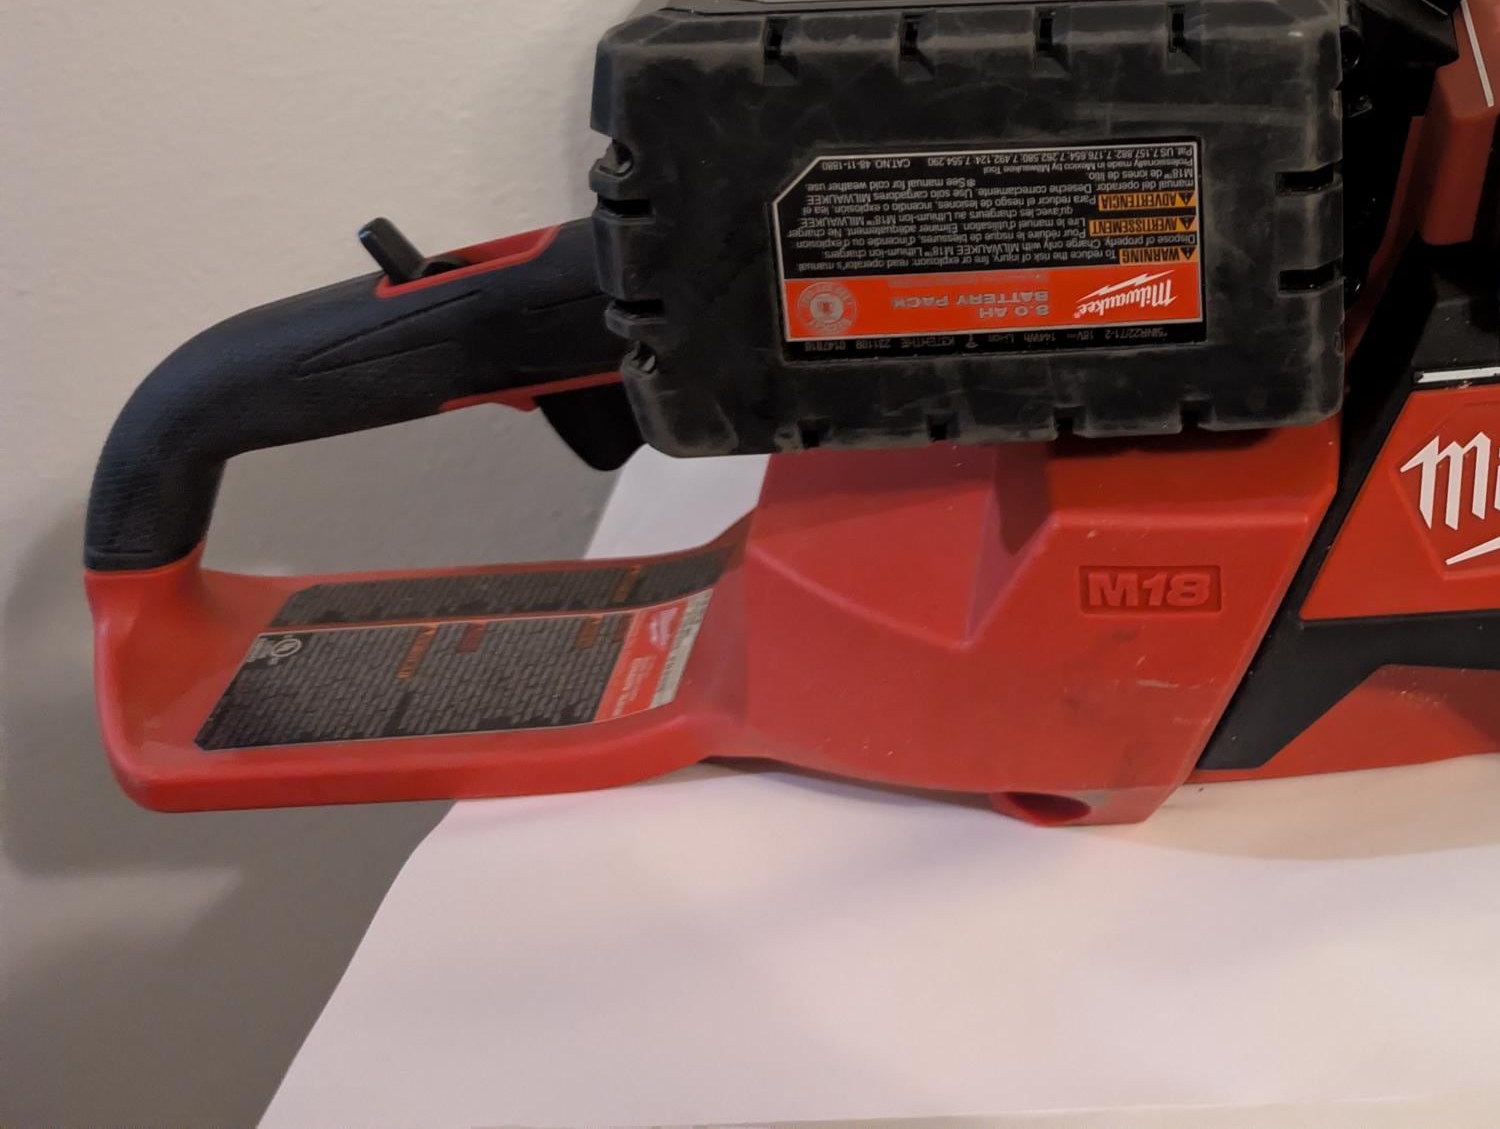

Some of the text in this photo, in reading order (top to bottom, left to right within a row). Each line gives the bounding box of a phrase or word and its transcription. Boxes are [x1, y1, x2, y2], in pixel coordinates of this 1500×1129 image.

[1063, 162, 1095, 171] Mexico
[1106, 160, 1131, 169] made
[1133, 155, 1192, 168] Professionally
[983, 166, 1001, 174] Tool
[1003, 164, 1049, 173] Milwaukee
[1122, 169, 1147, 179] iones
[1086, 171, 1104, 181] litio.
[828, 181, 866, 192] weather
[869, 180, 889, 190] cold
[892, 179, 905, 189] for
[907, 178, 943, 189] manual
[946, 177, 965, 187] See
[1141, 180, 1156, 190] del
[1158, 179, 1193, 190] manual
[872, 187, 928, 201] cargadores
[952, 188, 972, 198] Use
[1049, 183, 1091, 194] Deseche
[806, 192, 870, 204] MILWAUKEE
[994, 195, 1024, 207] riesgo
[1038, 196, 1070, 206] reducir
[1073, 195, 1096, 204] Para
[1100, 193, 1176, 208] ADVERTENCIA
[814, 205, 829, 215] lea
[891, 201, 932, 212] incendio
[1035, 204, 1073, 217] qu'avec
[969, 206, 1017, 220] chargeurs
[1019, 208, 1033, 218] les
[1018, 218, 1053, 229] manuel
[1067, 217, 1085, 227] Lire
[1091, 217, 1176, 233] AVERTISSEMENT
[786, 225, 825, 238] charger
[984, 229, 1013, 241] risque
[1063, 229, 1085, 238] Pour
[1043, 237, 1063, 250] only
[1065, 236, 1100, 249] Charge
[1157, 232, 1195, 245] Dispose
[956, 242, 1018, 253] MILWAUKEE
[1021, 241, 1041, 251] with
[974, 254, 989, 264] fire
[1033, 252, 1049, 261] risk
[1052, 251, 1067, 260] the
[1070, 250, 1102, 260] reduce
[1121, 247, 1179, 261] WARNING
[887, 258, 908, 267] read
[891, 290, 1048, 307] BATTERY PACK
[978, 306, 1007, 318] AH
[1088, 572, 1212, 606] M18
